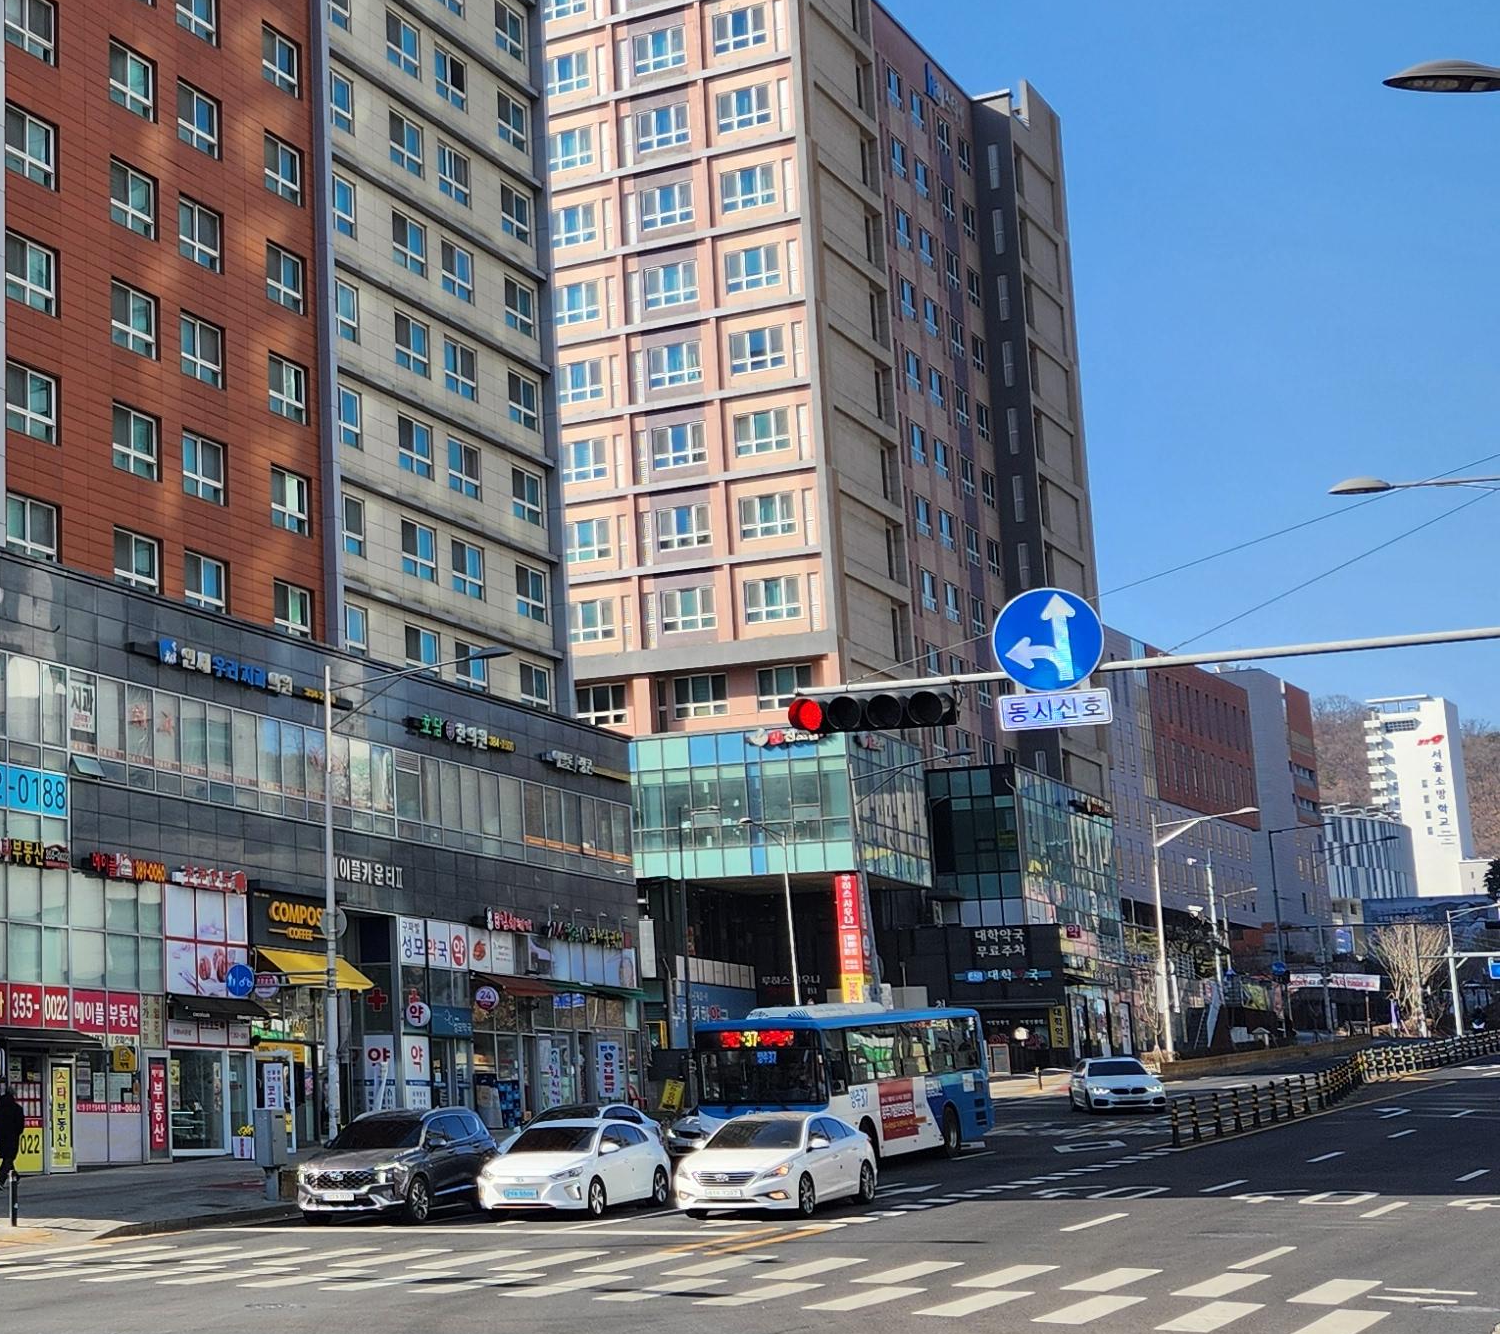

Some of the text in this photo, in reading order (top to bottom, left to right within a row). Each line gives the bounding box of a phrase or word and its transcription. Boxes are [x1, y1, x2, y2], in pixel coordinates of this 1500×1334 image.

[1007, 696, 1105, 723] 동시신호
[269, 900, 326, 928] COMPOS
[974, 928, 1026, 942] 대학약국
[1066, 924, 1079, 939] 약
[401, 935, 448, 960] 성모약국
[453, 940, 465, 965] 약
[976, 943, 1027, 958] 무료주차
[12, 991, 69, 1022] 355-0022
[74, 1000, 105, 1027] 메이플
[108, 1003, 139, 1028] 부동산
[409, 1005, 424, 1023] 약
[410, 1045, 424, 1073] 약
[109, 1103, 141, 1113] 389-0060
[153, 1081, 165, 1143] 부동산
